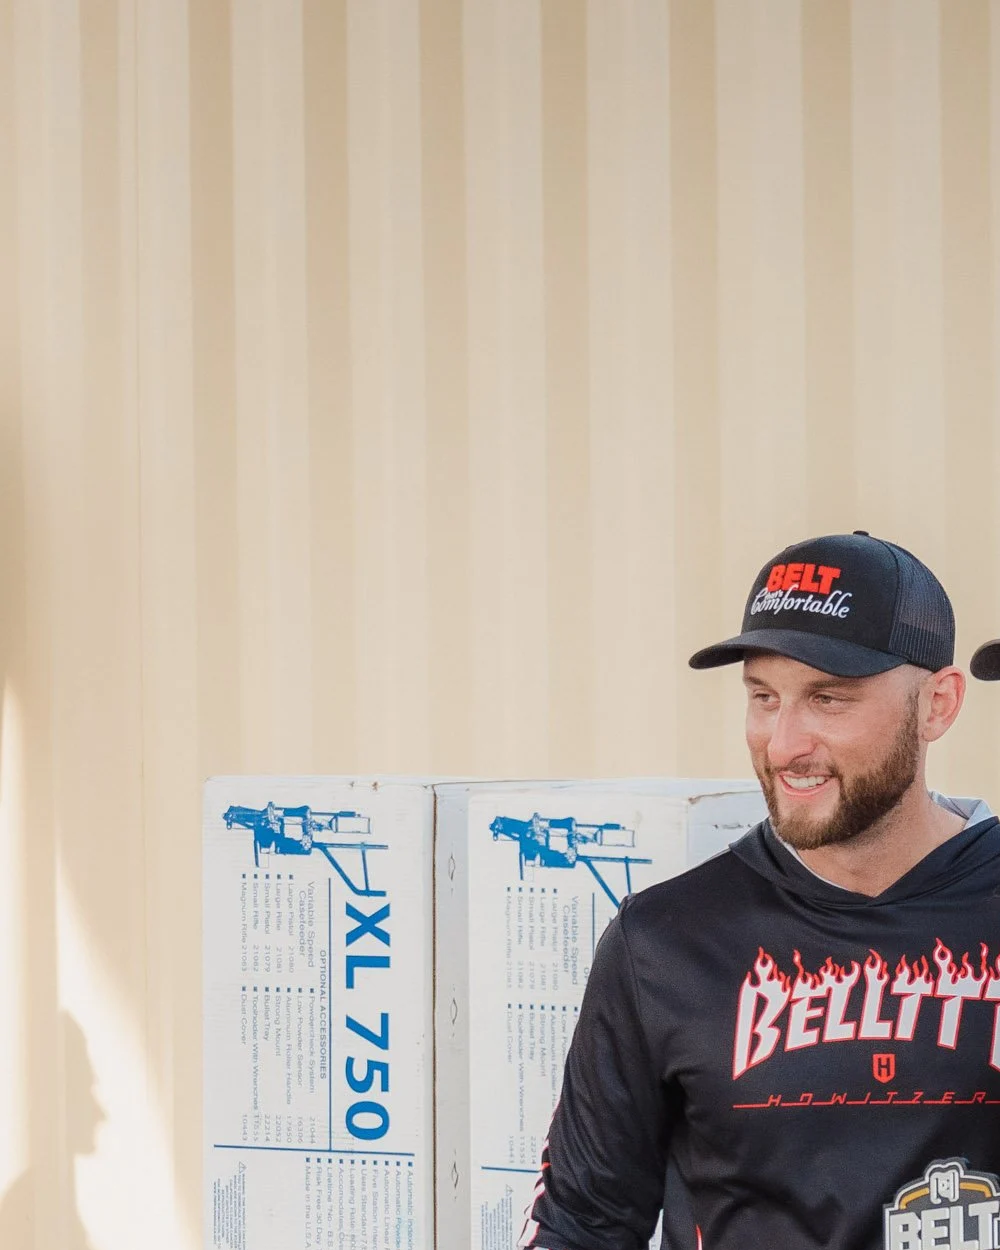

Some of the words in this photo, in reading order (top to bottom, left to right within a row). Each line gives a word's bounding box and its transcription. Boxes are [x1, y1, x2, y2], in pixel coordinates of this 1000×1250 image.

[750, 583, 853, 618] Comfortable
[766, 563, 841, 595] BELT
[298, 890, 306, 957] Casefeeder
[307, 880, 316, 927] Variable
[307, 930, 316, 968] Speed
[345, 901, 391, 989] XL
[319, 949, 327, 1002] OPTIONAL
[319, 1005, 327, 1080] ACCESSORIES
[345, 1012, 391, 1141] 750
[768, 1091, 986, 1107] HOWITZER
[406, 1170, 414, 1216] Automatic
